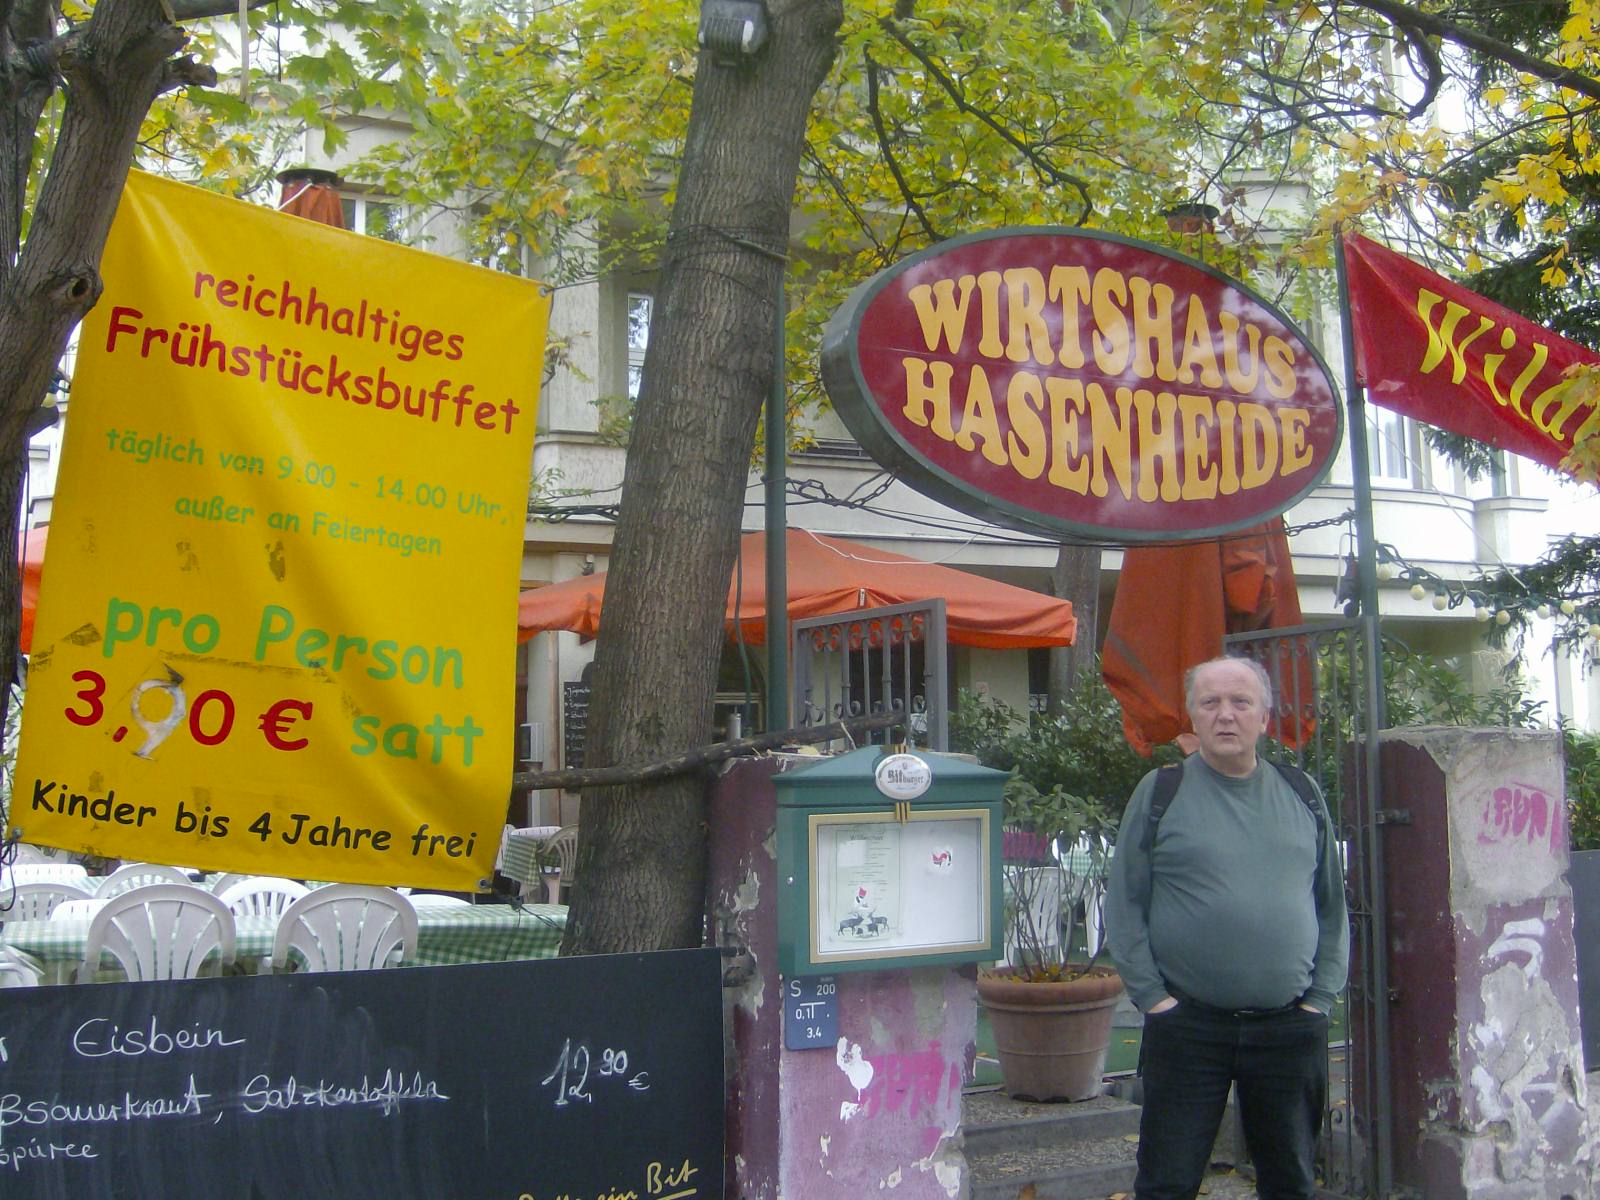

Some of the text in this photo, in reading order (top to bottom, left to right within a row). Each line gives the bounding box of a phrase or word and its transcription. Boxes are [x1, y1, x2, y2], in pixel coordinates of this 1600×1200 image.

[193, 271, 465, 362] reichhaltiges
[907, 265, 1297, 400] WIRTSHAUS
[106, 305, 521, 434] Frühstücksbuffet
[106, 427, 204, 464] täglich
[219, 451, 265, 476] von
[277, 454, 337, 490] 9.00
[376, 474, 448, 510] 14.00
[902, 356, 1313, 503] HASENHEIDE
[175, 495, 443, 557] außer an Feiertagen
[103, 597, 464, 689] pro Person
[64, 667, 314, 760] 3,90 €
[350, 713, 485, 768] satt
[31, 779, 478, 859] Kinder bis 4 Jahre frei
[790, 980, 836, 997] S 200
[73, 1015, 247, 1057] Eisbein
[647, 1159, 699, 1195] Bit
